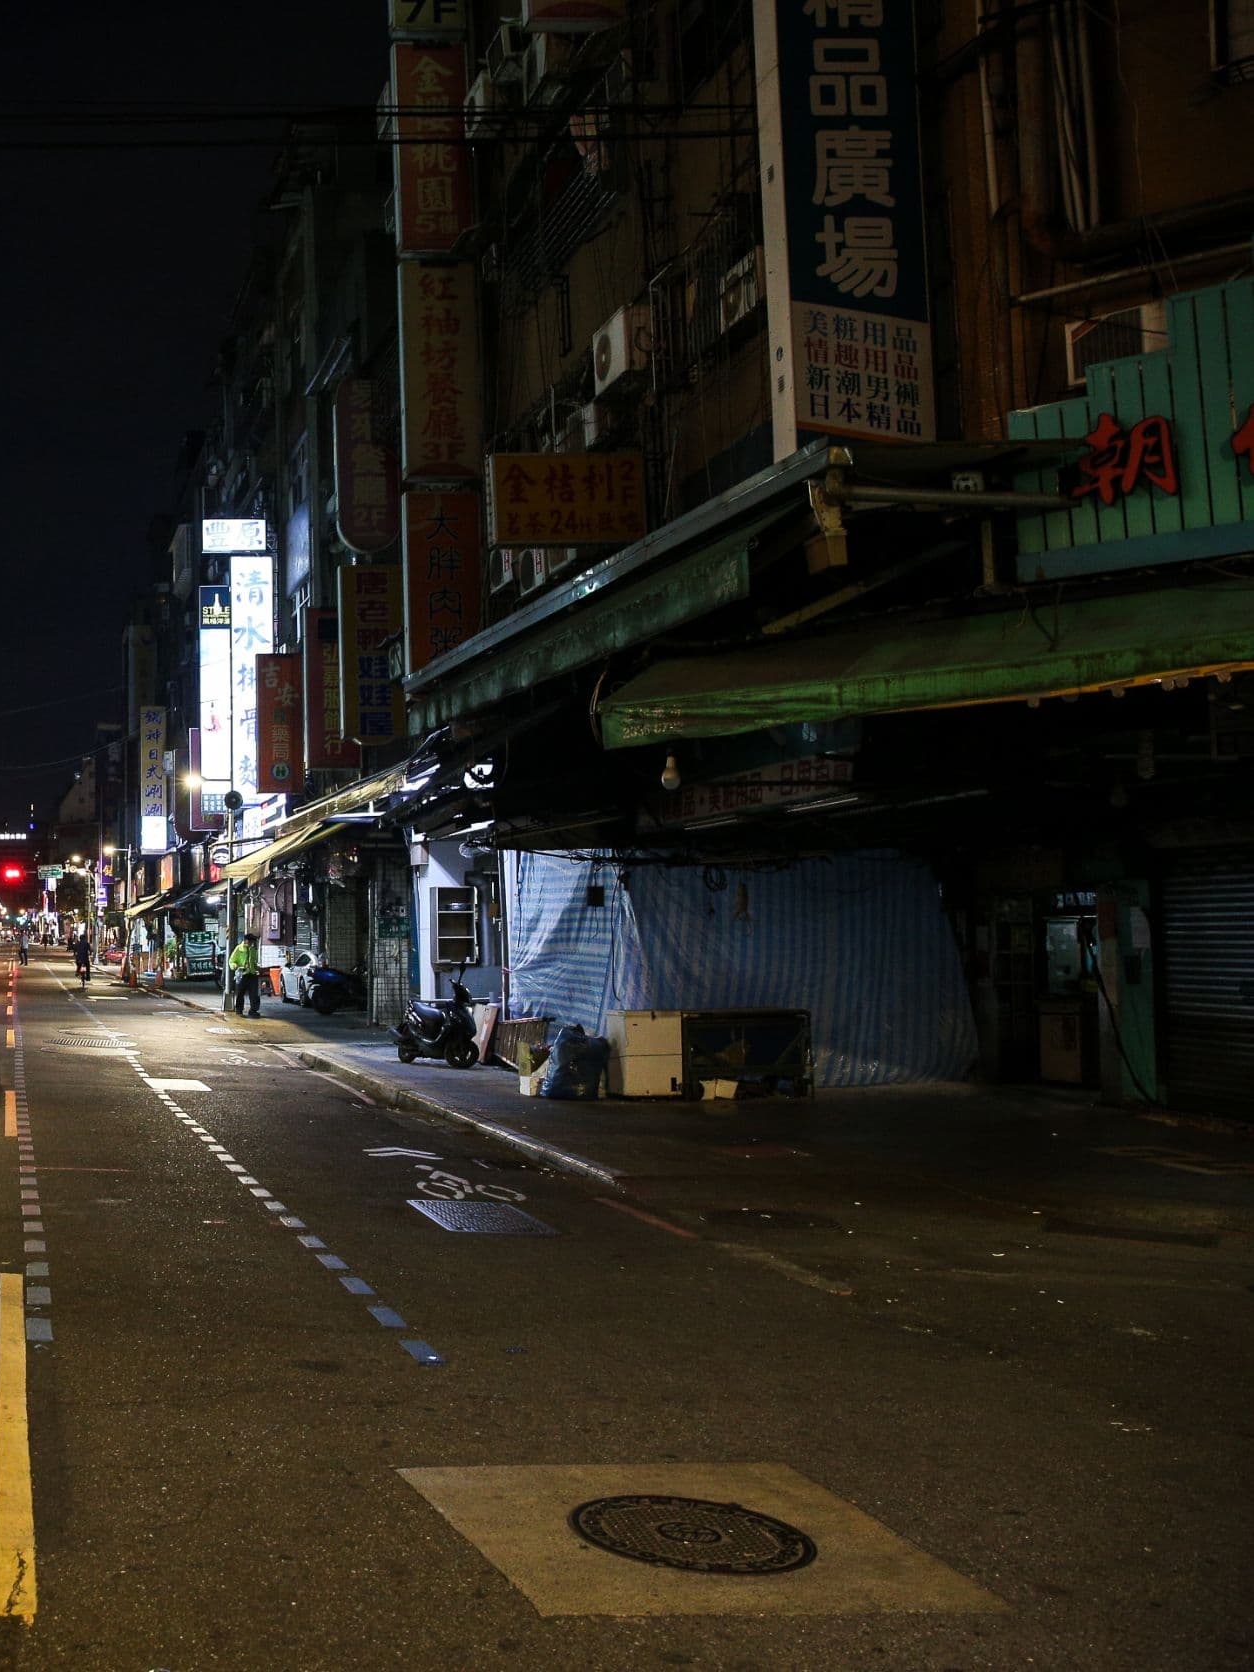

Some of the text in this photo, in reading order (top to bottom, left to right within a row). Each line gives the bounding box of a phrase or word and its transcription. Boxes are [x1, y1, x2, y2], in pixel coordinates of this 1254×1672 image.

[805, 310, 917, 354] 美粧用品
[804, 337, 918, 380] 情趣用品
[809, 392, 922, 437] 日本精品
[205, 521, 263, 548] 豐原
[202, 606, 231, 616] STLE
